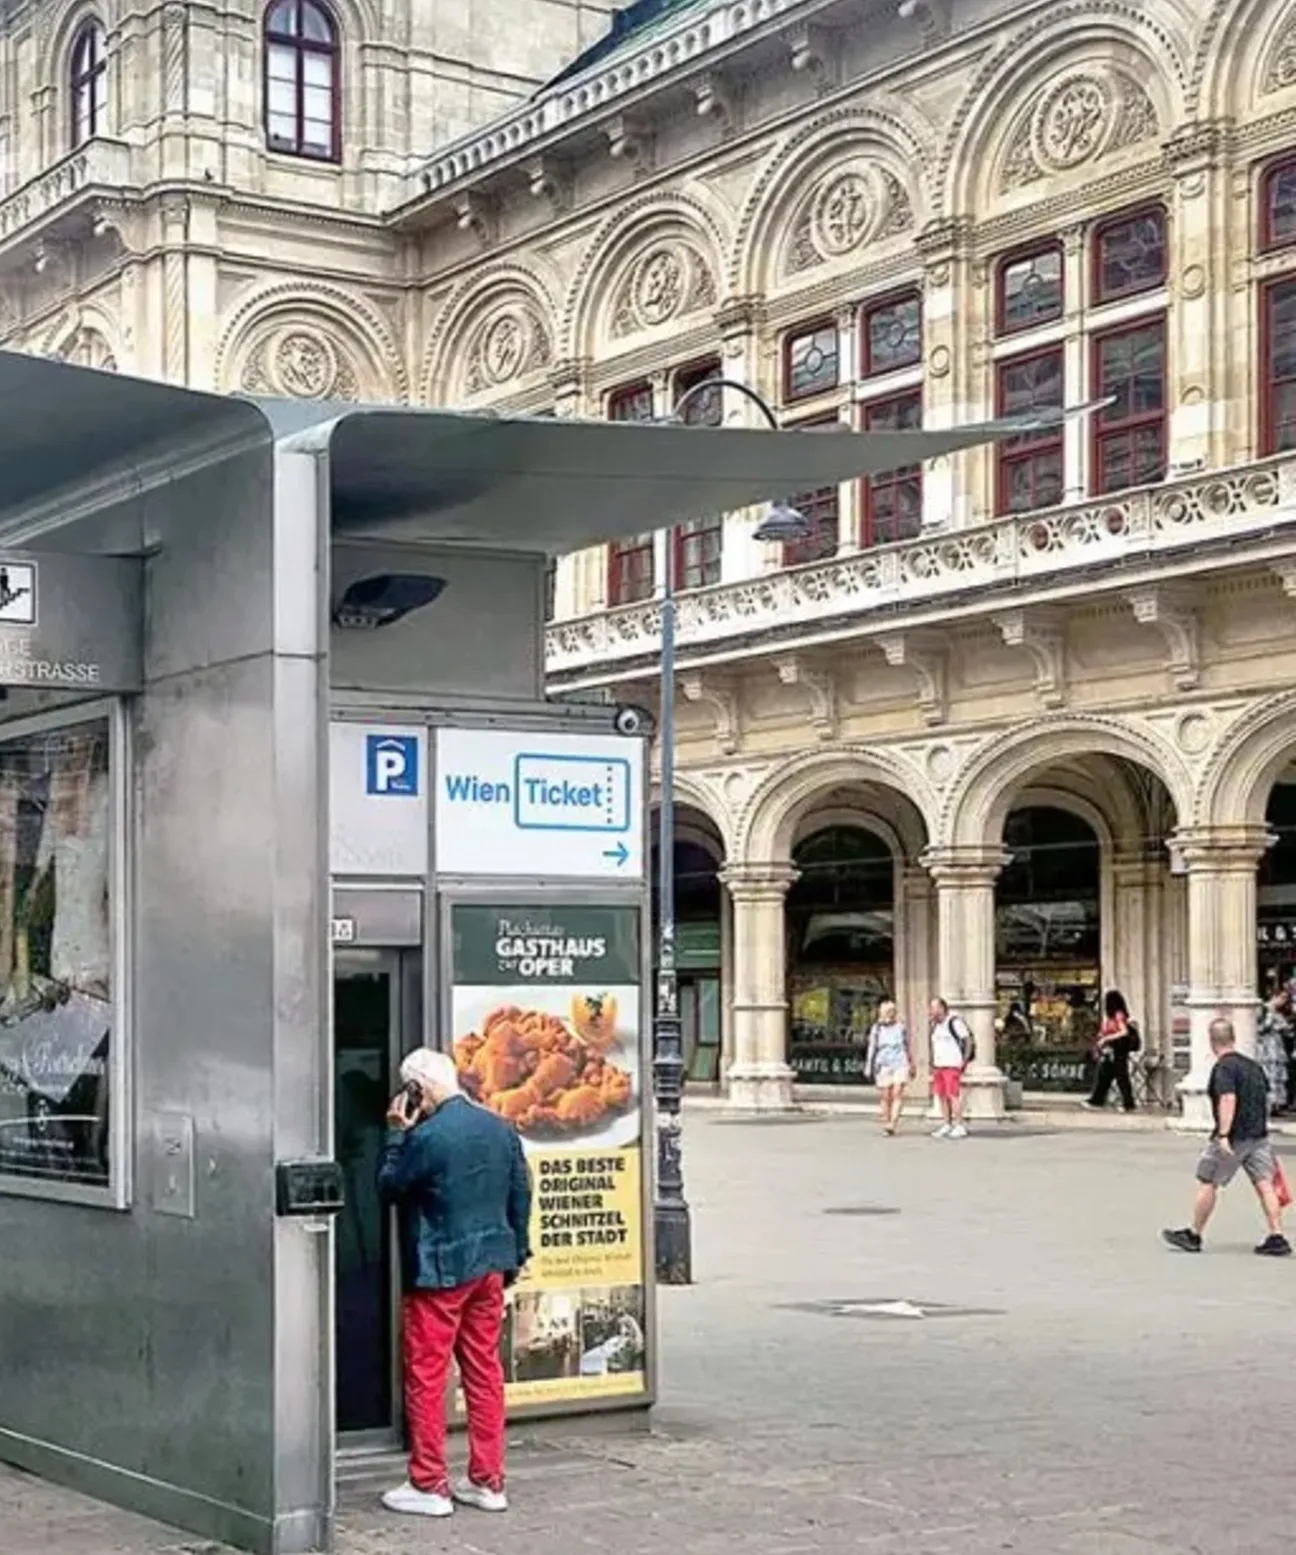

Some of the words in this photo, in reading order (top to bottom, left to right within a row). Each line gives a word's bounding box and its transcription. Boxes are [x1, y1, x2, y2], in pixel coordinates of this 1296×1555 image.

[376, 751, 405, 791] P
[445, 775, 510, 803] Wien
[524, 777, 603, 807] Ticket
[495, 937, 606, 957] GASTHAUS
[519, 957, 574, 976] OPER
[540, 1159, 572, 1174] DAS
[577, 1157, 626, 1173] BESTE
[540, 1176, 615, 1193] ORIGINAL
[539, 1194, 603, 1211] WIENER
[540, 1211, 625, 1229] SCHNITZEL
[541, 1231, 572, 1247] DER
[577, 1228, 628, 1245] STADT
